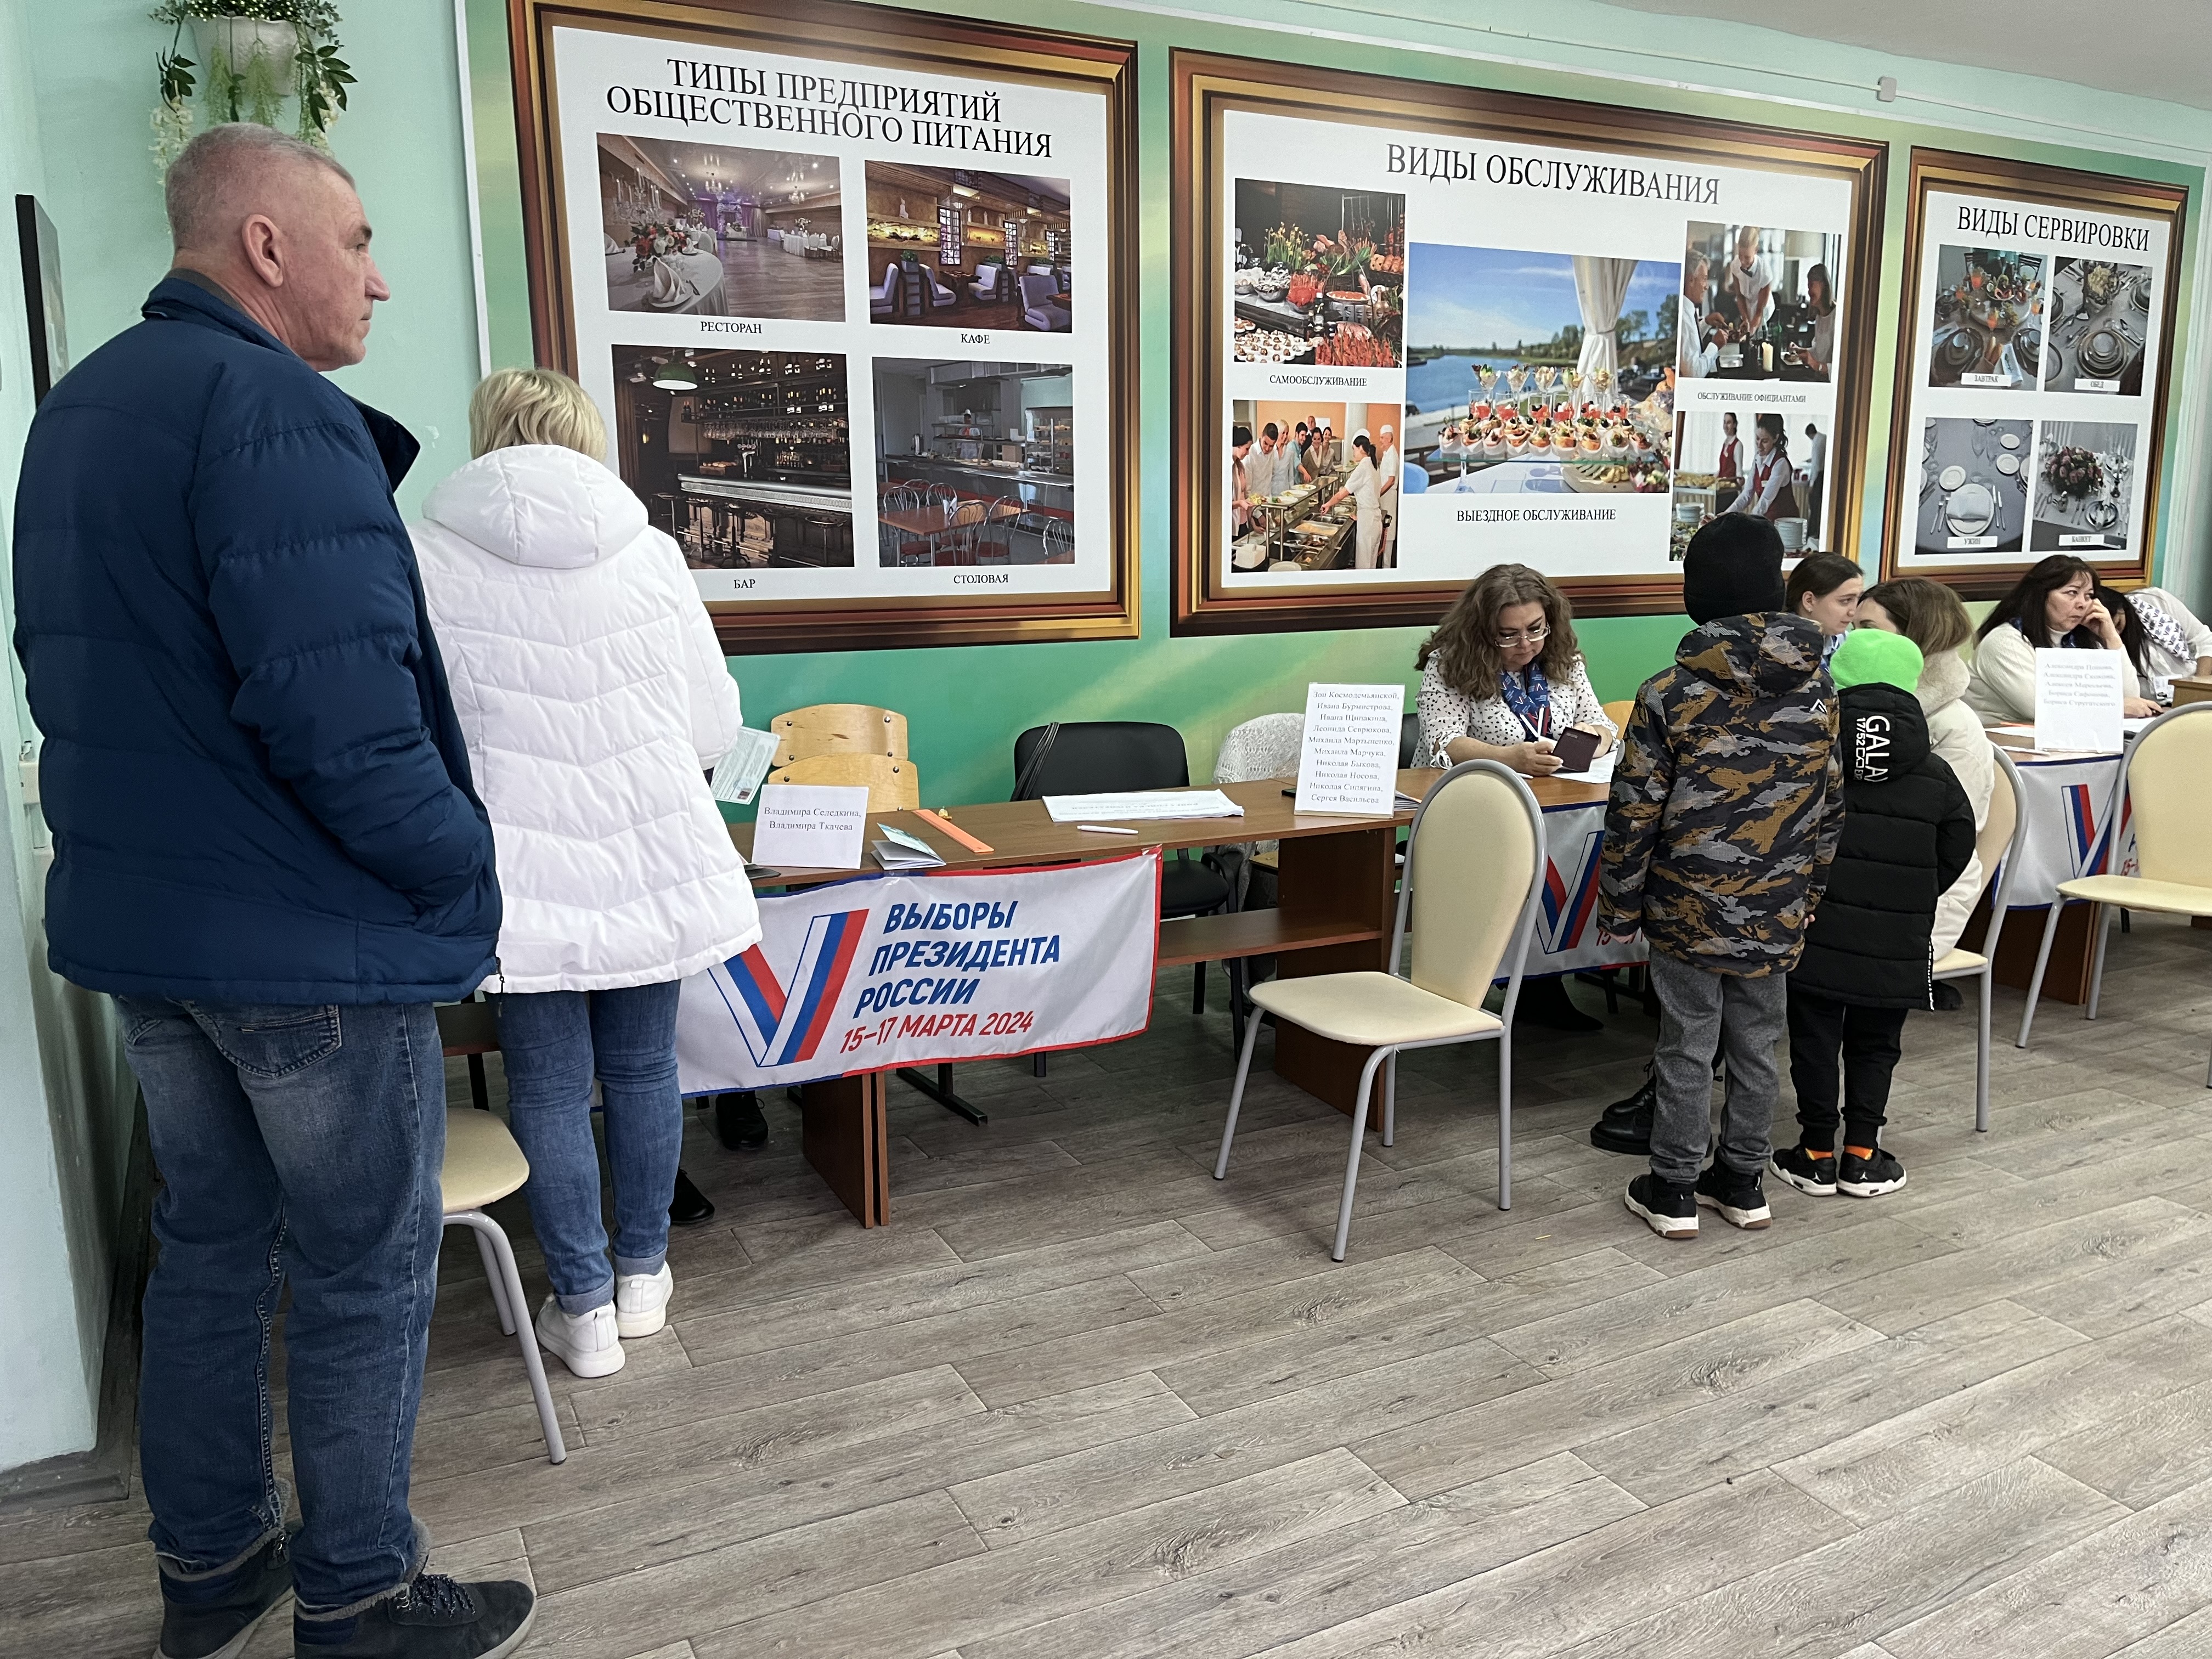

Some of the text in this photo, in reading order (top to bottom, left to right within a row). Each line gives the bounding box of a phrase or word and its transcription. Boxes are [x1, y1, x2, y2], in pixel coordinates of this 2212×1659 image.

[667, 59, 1001, 122] ТИПЫ ПРЕДПРИЯТИЙ
[607, 86, 1052, 157] ОБЩЕСТВЕННОГО ПИТАНИЯ
[1386, 143, 1720, 205] ВИДЫ ОБСЛУЖИВАНИЯ
[1957, 206, 2149, 251] ВИДЫ СЕРВИРОВКИ
[700, 321, 762, 334] РЕСТОРАН
[961, 333, 990, 344] КАФЕ
[1269, 375, 1367, 386] САМООБСЛУЖИВАНИЕ
[1697, 392, 1806, 403] ОБСЛУЖИВАНИЕ ОФИЦИАНТАМИ
[1457, 509, 1616, 523] ВЫЕЗДНОЕ ОБСЛУЖИВАНИЕ
[733, 579, 755, 589] БАР
[953, 574, 1008, 584] СТОЛОВАЯ
[1329, 691, 1399, 699] Космодемьянской,
[1342, 703, 1393, 711] Бурмистрова,
[1347, 725, 1392, 734] Севрюкова,
[1345, 737, 1395, 746] Мартыненко,
[1350, 749, 1386, 758] Марчука,
[1351, 760, 1381, 769] Быкова,
[1350, 772, 1380, 780] Носова,
[1311, 794, 1379, 803] Сергея Васильева
[764, 807, 861, 818] Владимира Селедкина,
[769, 821, 853, 831] Владимира Ткачева
[883, 901, 1018, 934] ВЫБОРЫ
[868, 935, 1060, 977] ПРЕЗИДЕНТА
[853, 978, 980, 1019] РОССИИ
[897, 1014, 978, 1038] МАРТА
[979, 1011, 1034, 1036] 2024
